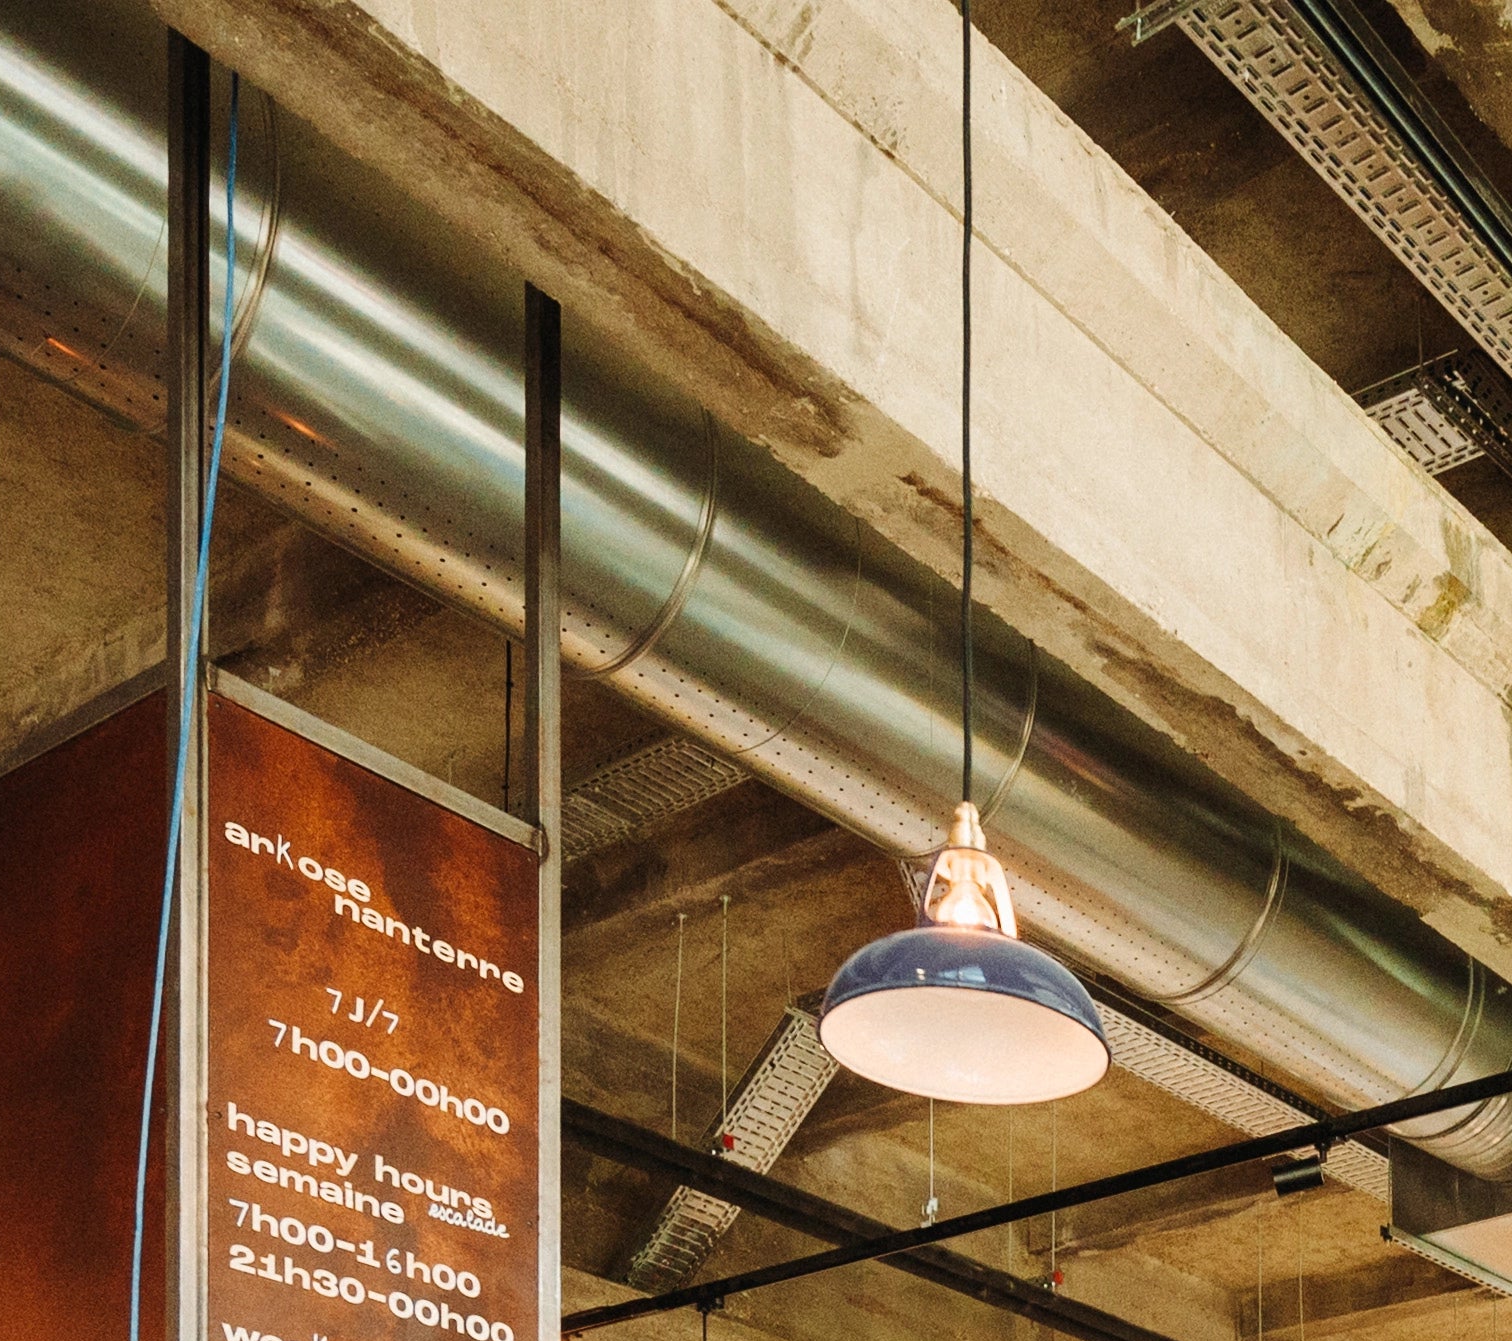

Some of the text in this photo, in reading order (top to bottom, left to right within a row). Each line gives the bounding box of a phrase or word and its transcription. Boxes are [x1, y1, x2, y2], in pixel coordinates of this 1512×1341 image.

[268, 1018, 510, 1135] 7h00-00h00
[226, 1150, 510, 1239] semaine escalade
[227, 1101, 494, 1219] happy hours
[229, 1198, 481, 1299] 7h00-16h00
